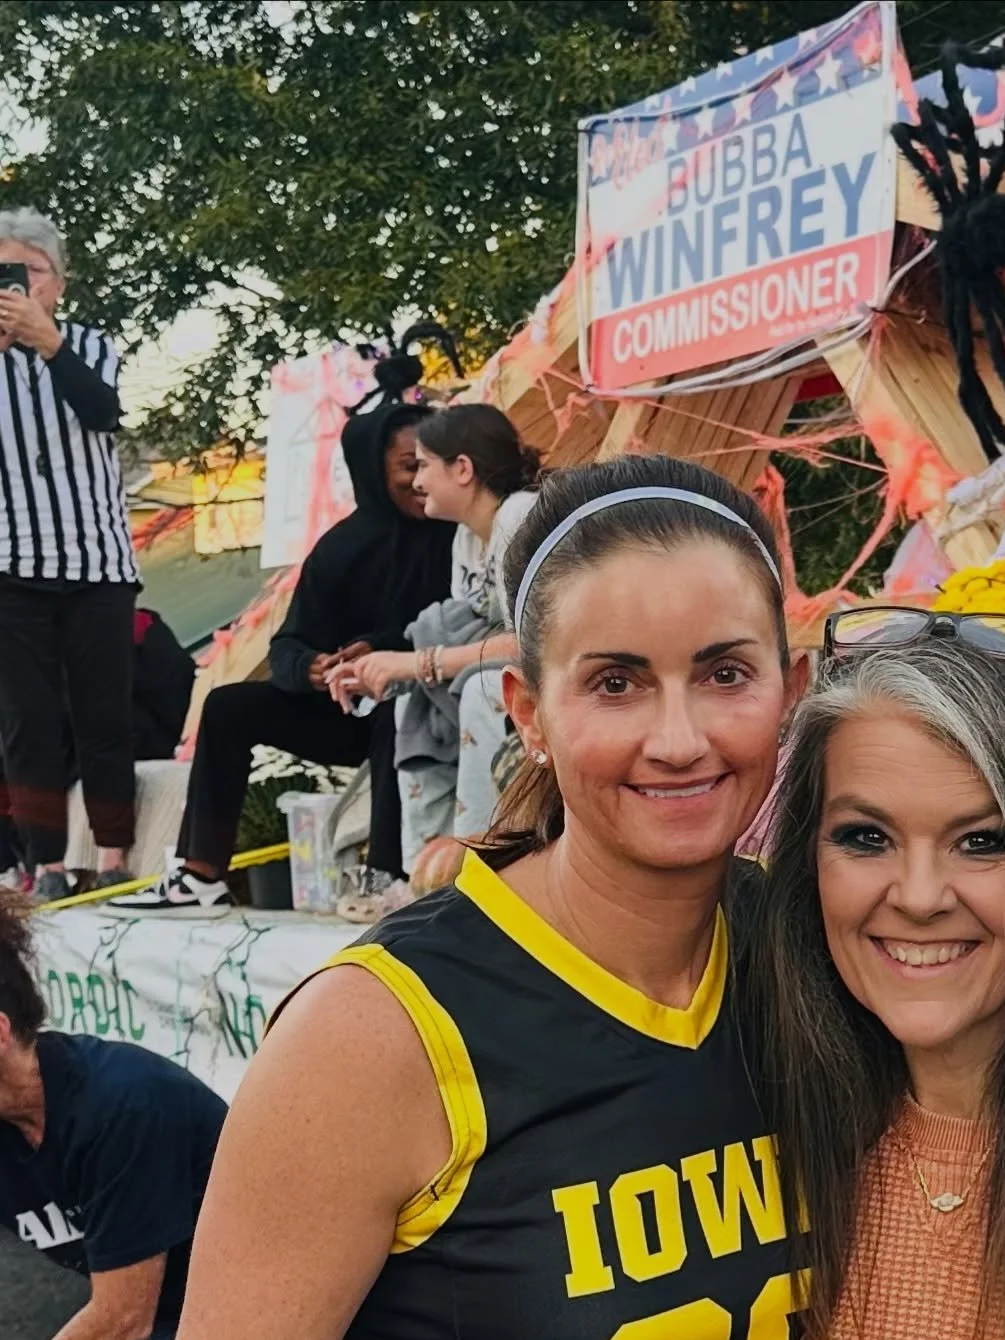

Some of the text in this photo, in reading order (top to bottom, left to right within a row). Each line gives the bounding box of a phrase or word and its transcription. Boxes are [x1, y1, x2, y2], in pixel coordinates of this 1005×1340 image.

[606, 152, 879, 310] WINFREY
[666, 113, 812, 216] BUBBA
[611, 252, 860, 363] COMMISSIONER
[552, 1134, 811, 1298] IOW
